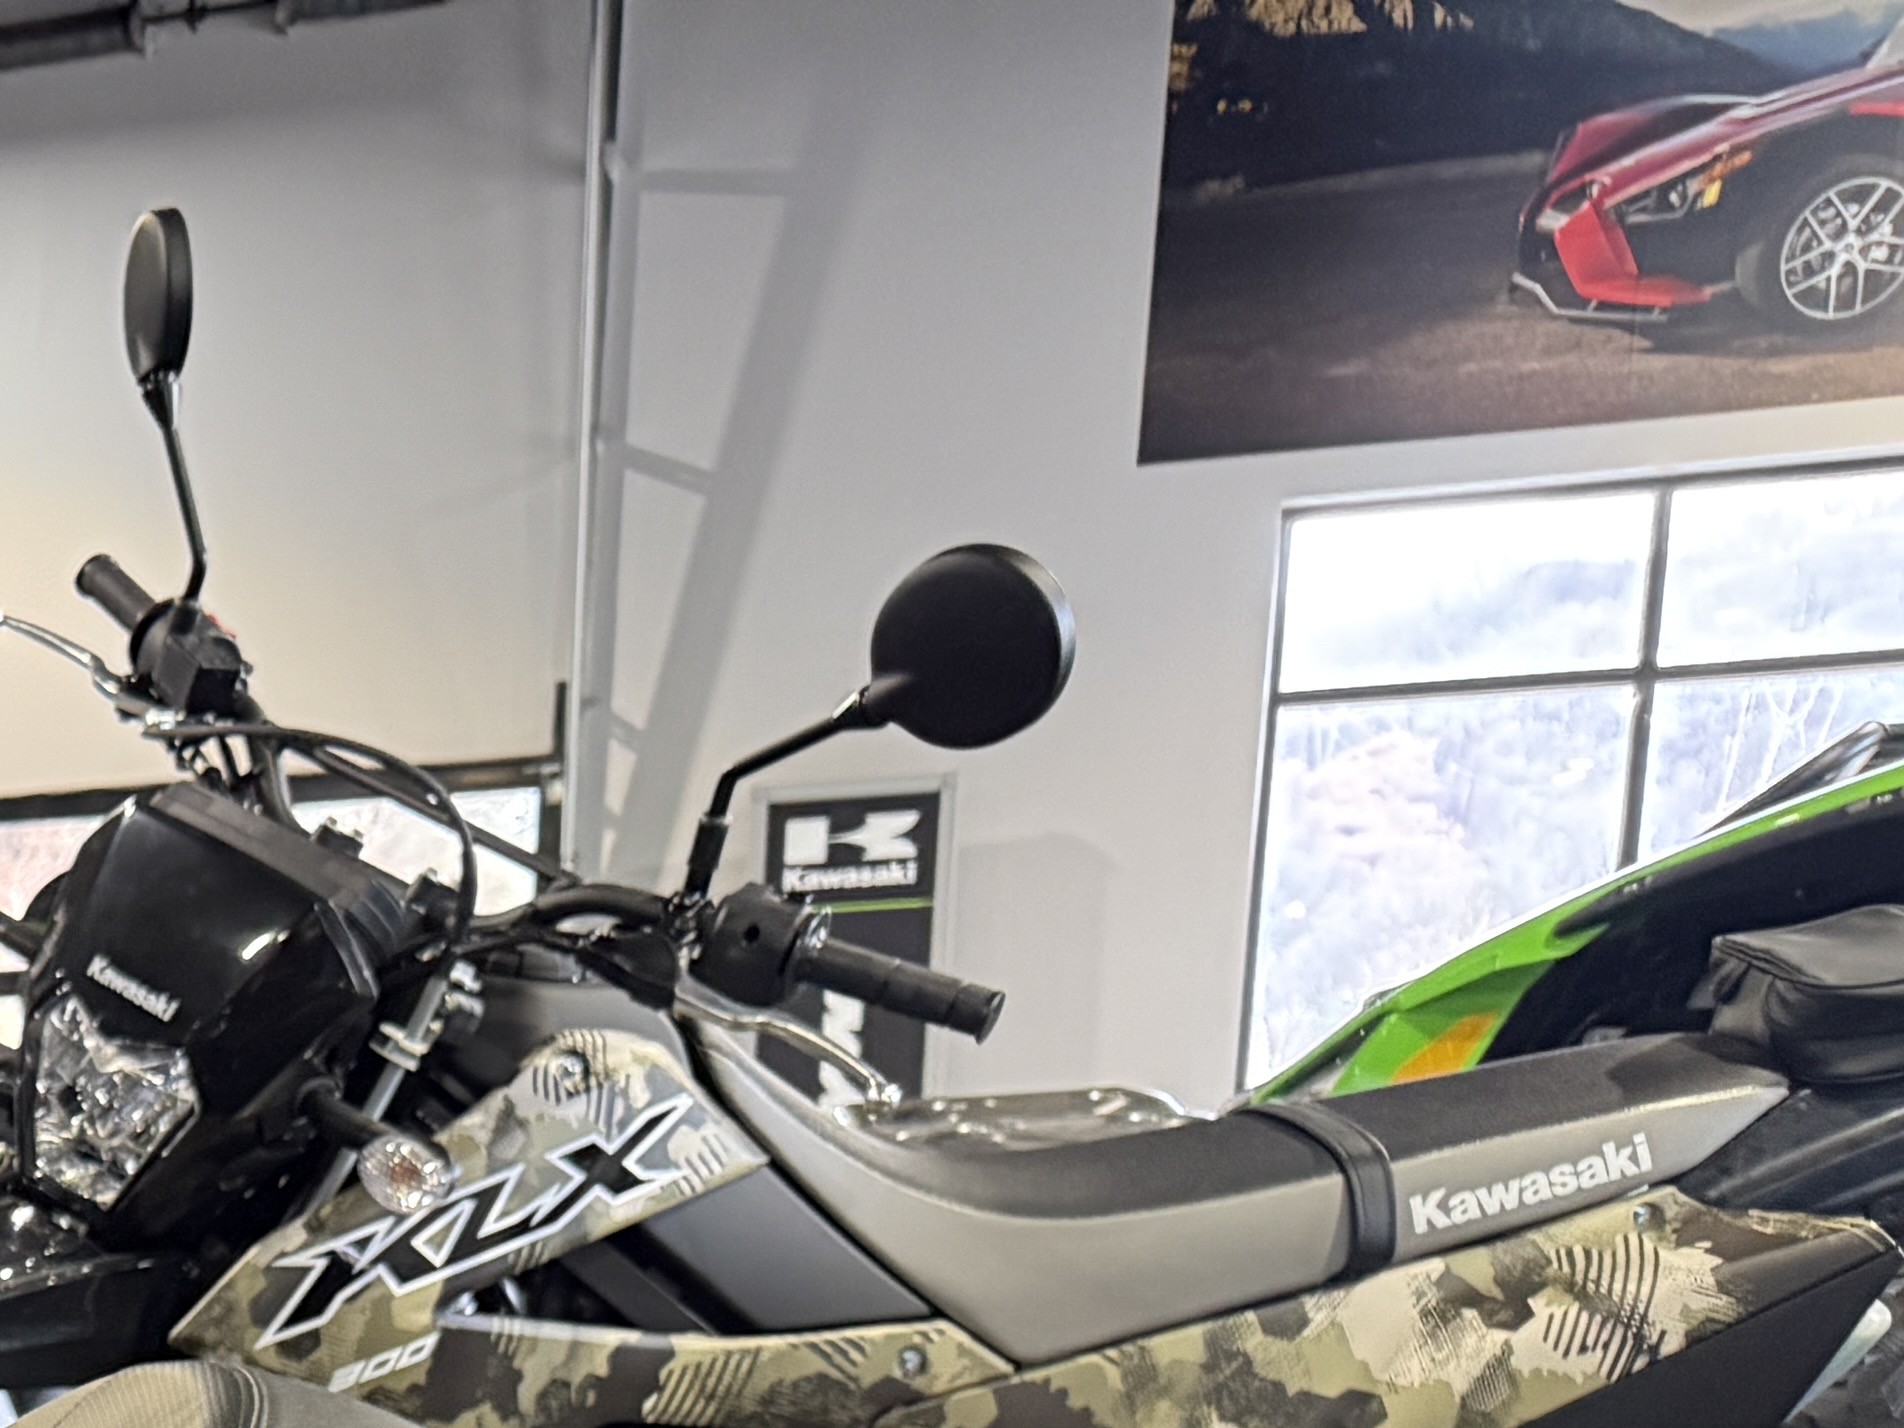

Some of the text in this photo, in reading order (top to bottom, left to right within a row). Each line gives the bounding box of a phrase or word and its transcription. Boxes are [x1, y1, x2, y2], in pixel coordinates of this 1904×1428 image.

[782, 861, 918, 893] Kawasaki
[86, 955, 181, 1022] Kawasaki
[256, 1094, 694, 1350] KLX
[1409, 1132, 1653, 1234] Kawasaki
